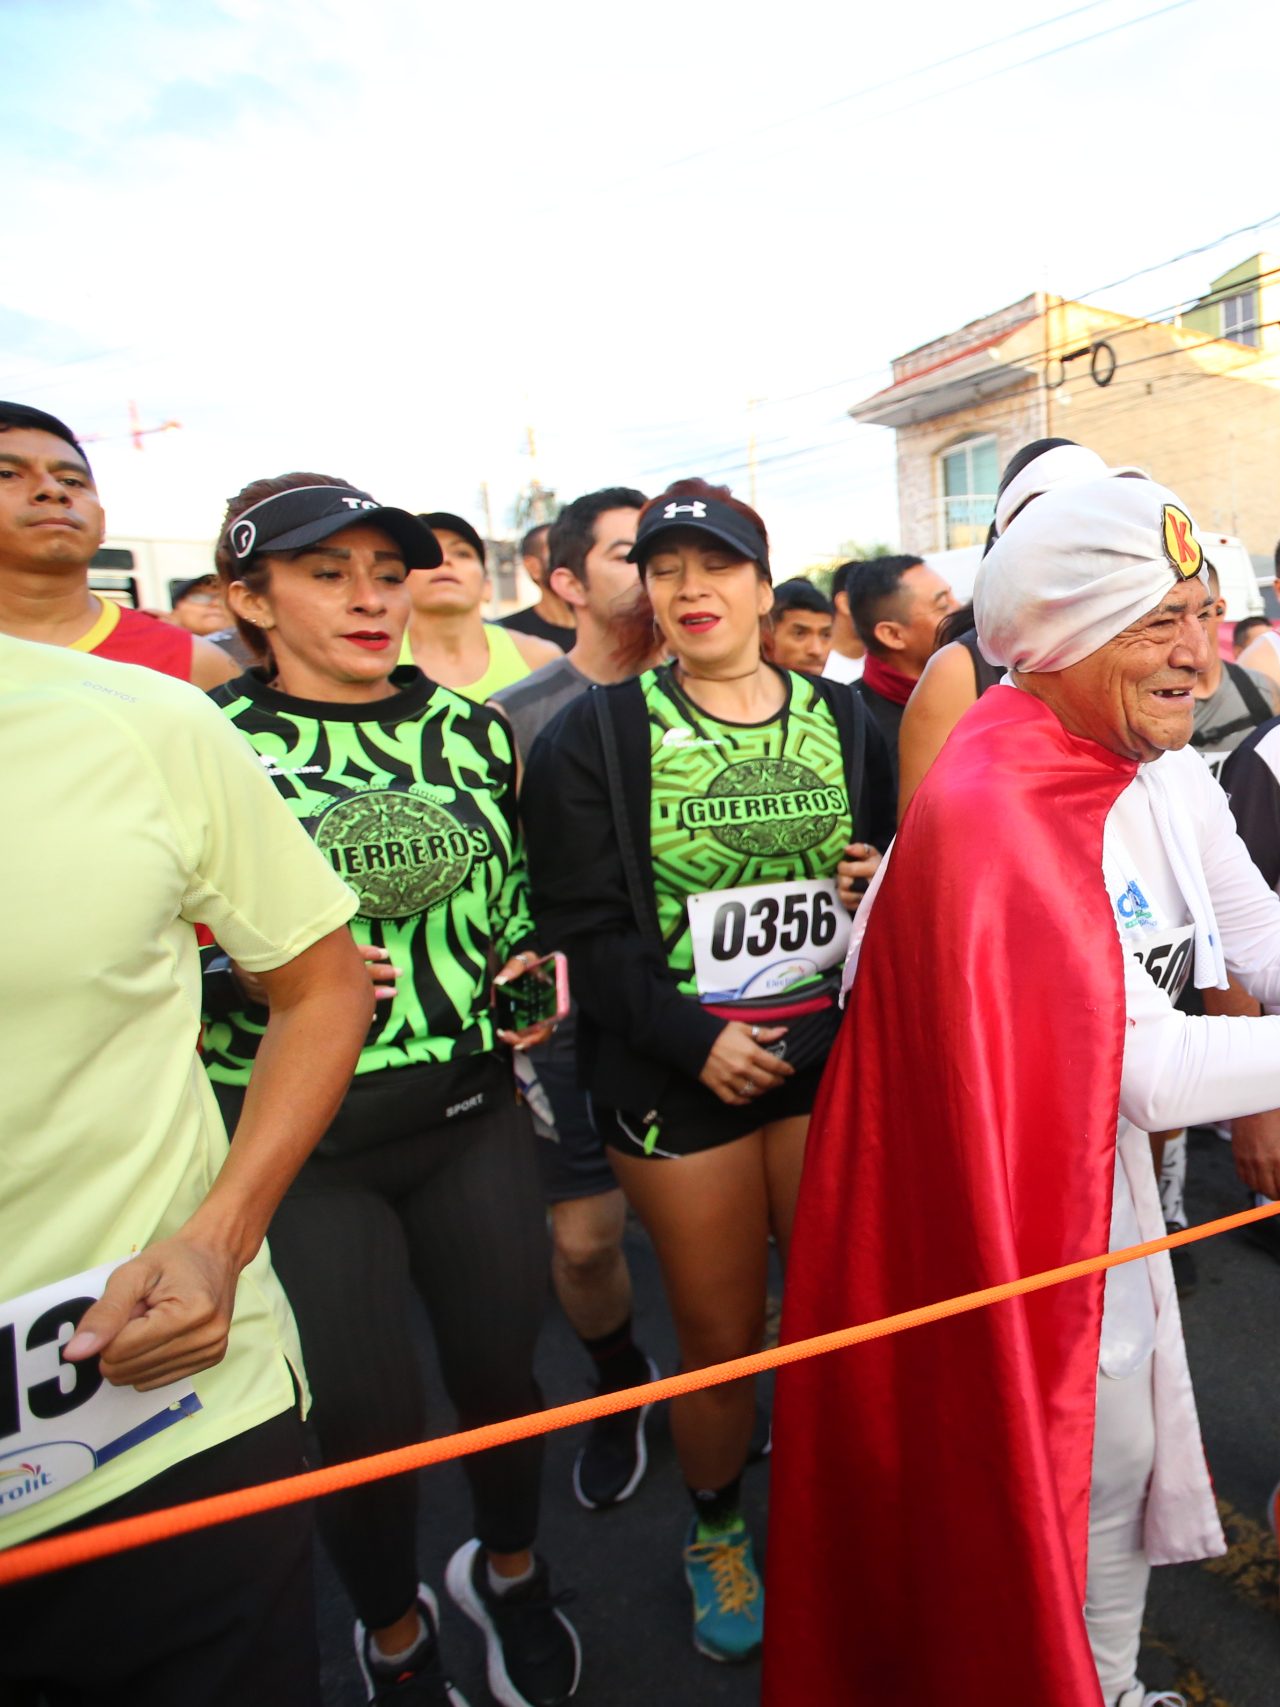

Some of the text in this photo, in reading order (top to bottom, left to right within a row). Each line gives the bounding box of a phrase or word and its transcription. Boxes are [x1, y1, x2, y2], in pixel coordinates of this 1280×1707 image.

[1167, 512, 1197, 563] K
[687, 791, 842, 823] GUERREROS
[711, 891, 837, 961] 0356
[446, 1093, 483, 1118] SPORT
